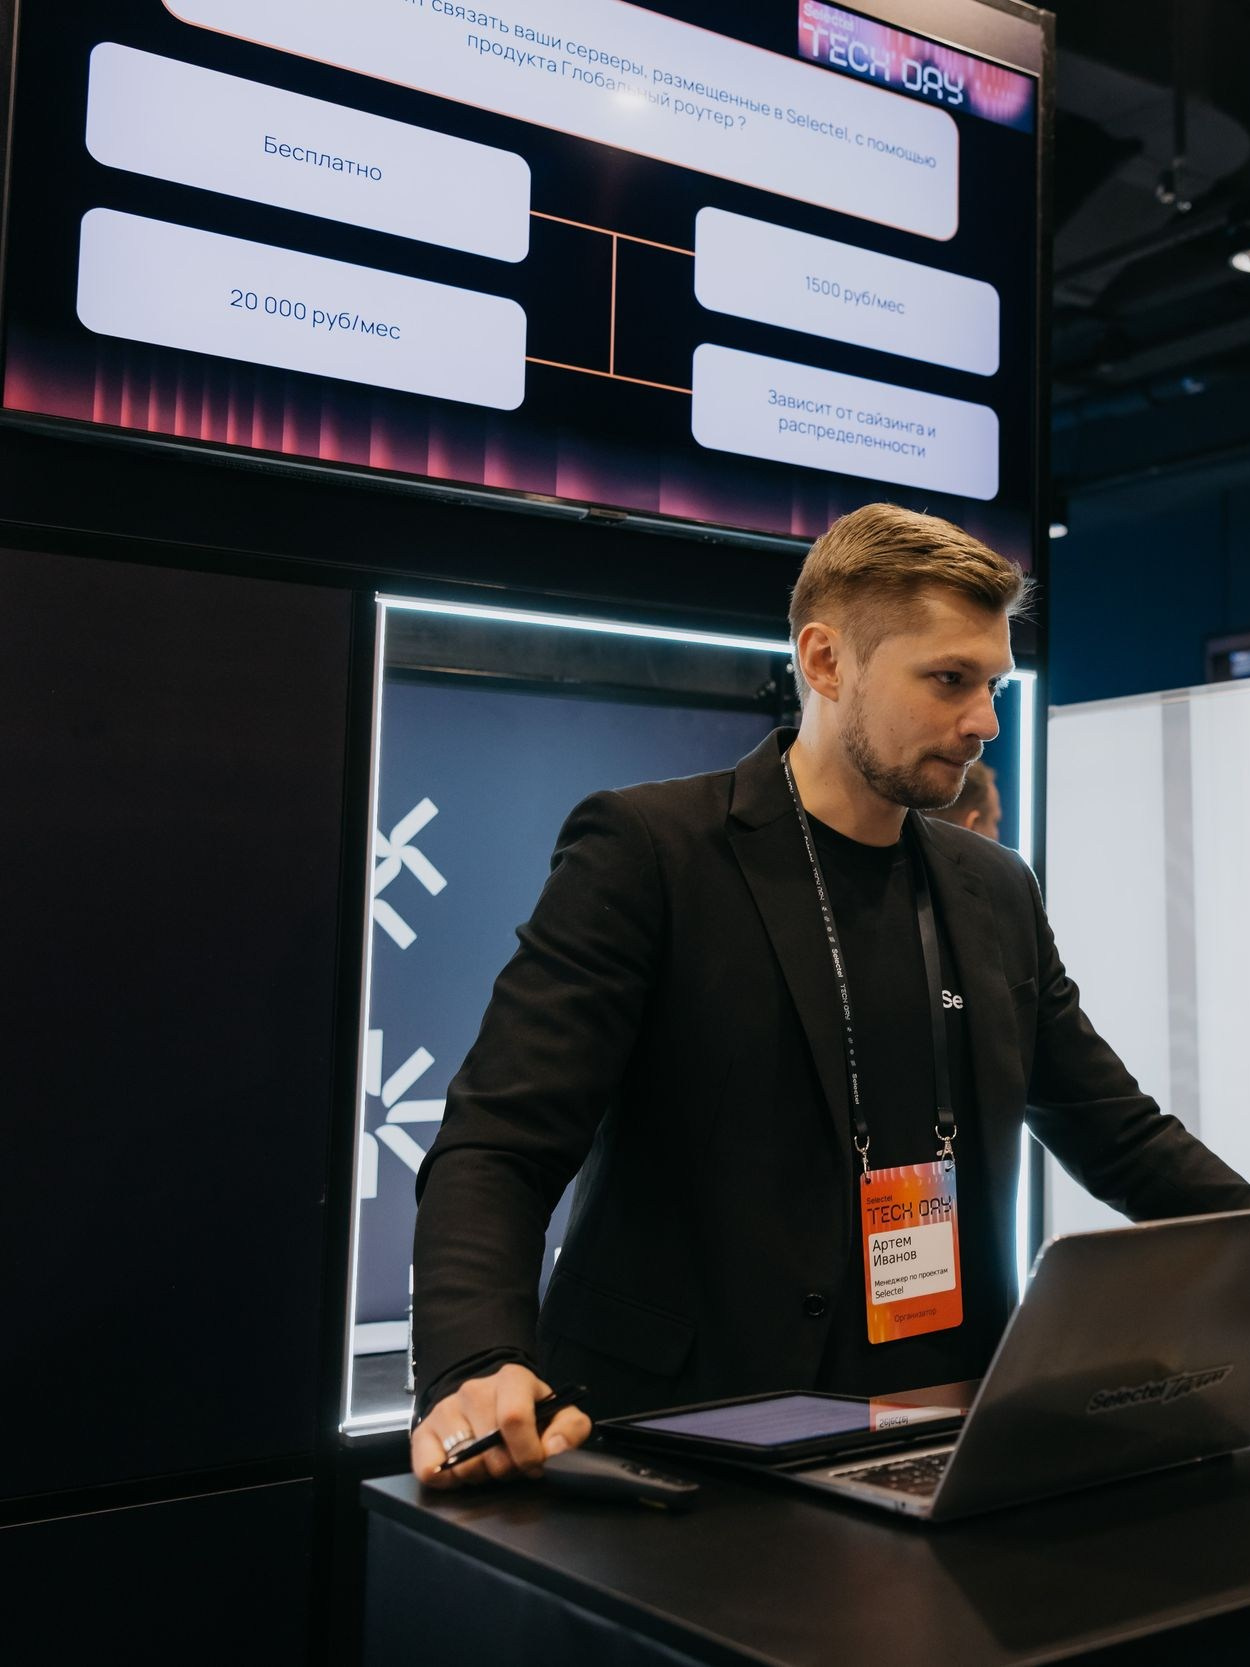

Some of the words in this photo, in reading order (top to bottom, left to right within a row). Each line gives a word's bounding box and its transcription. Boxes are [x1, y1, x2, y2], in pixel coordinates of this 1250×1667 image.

[432, 0, 509, 33] связать
[514, 24, 562, 50] ваши
[653, 68, 770, 116] размещенные
[774, 108, 783, 120] в
[855, 133, 864, 145] с
[867, 136, 937, 168] помощью
[467, 34, 557, 73] продукта
[562, 60, 671, 107] Глобальный
[674, 99, 734, 129] роутер
[803, 23, 891, 82] TECH
[902, 58, 964, 105] DAY
[264, 135, 383, 182] Бесплатно
[229, 289, 259, 311] 20
[264, 296, 307, 321] 000
[312, 307, 401, 341] руб/мес
[805, 275, 841, 298] 1500
[844, 288, 906, 315] руб/мес
[767, 389, 832, 417] Зависит
[836, 406, 854, 421] от
[857, 408, 926, 437] сайзинга
[928, 425, 937, 439] и
[778, 416, 927, 459] распределенности
[867, 1202, 913, 1225] TECH
[919, 1196, 952, 1217] DAY
[872, 1236, 912, 1253] Артем
[873, 1250, 917, 1267] Иванов
[874, 1276, 909, 1287] Менеджер
[918, 1268, 949, 1280] проектам
[875, 1286, 904, 1299] Selectel
